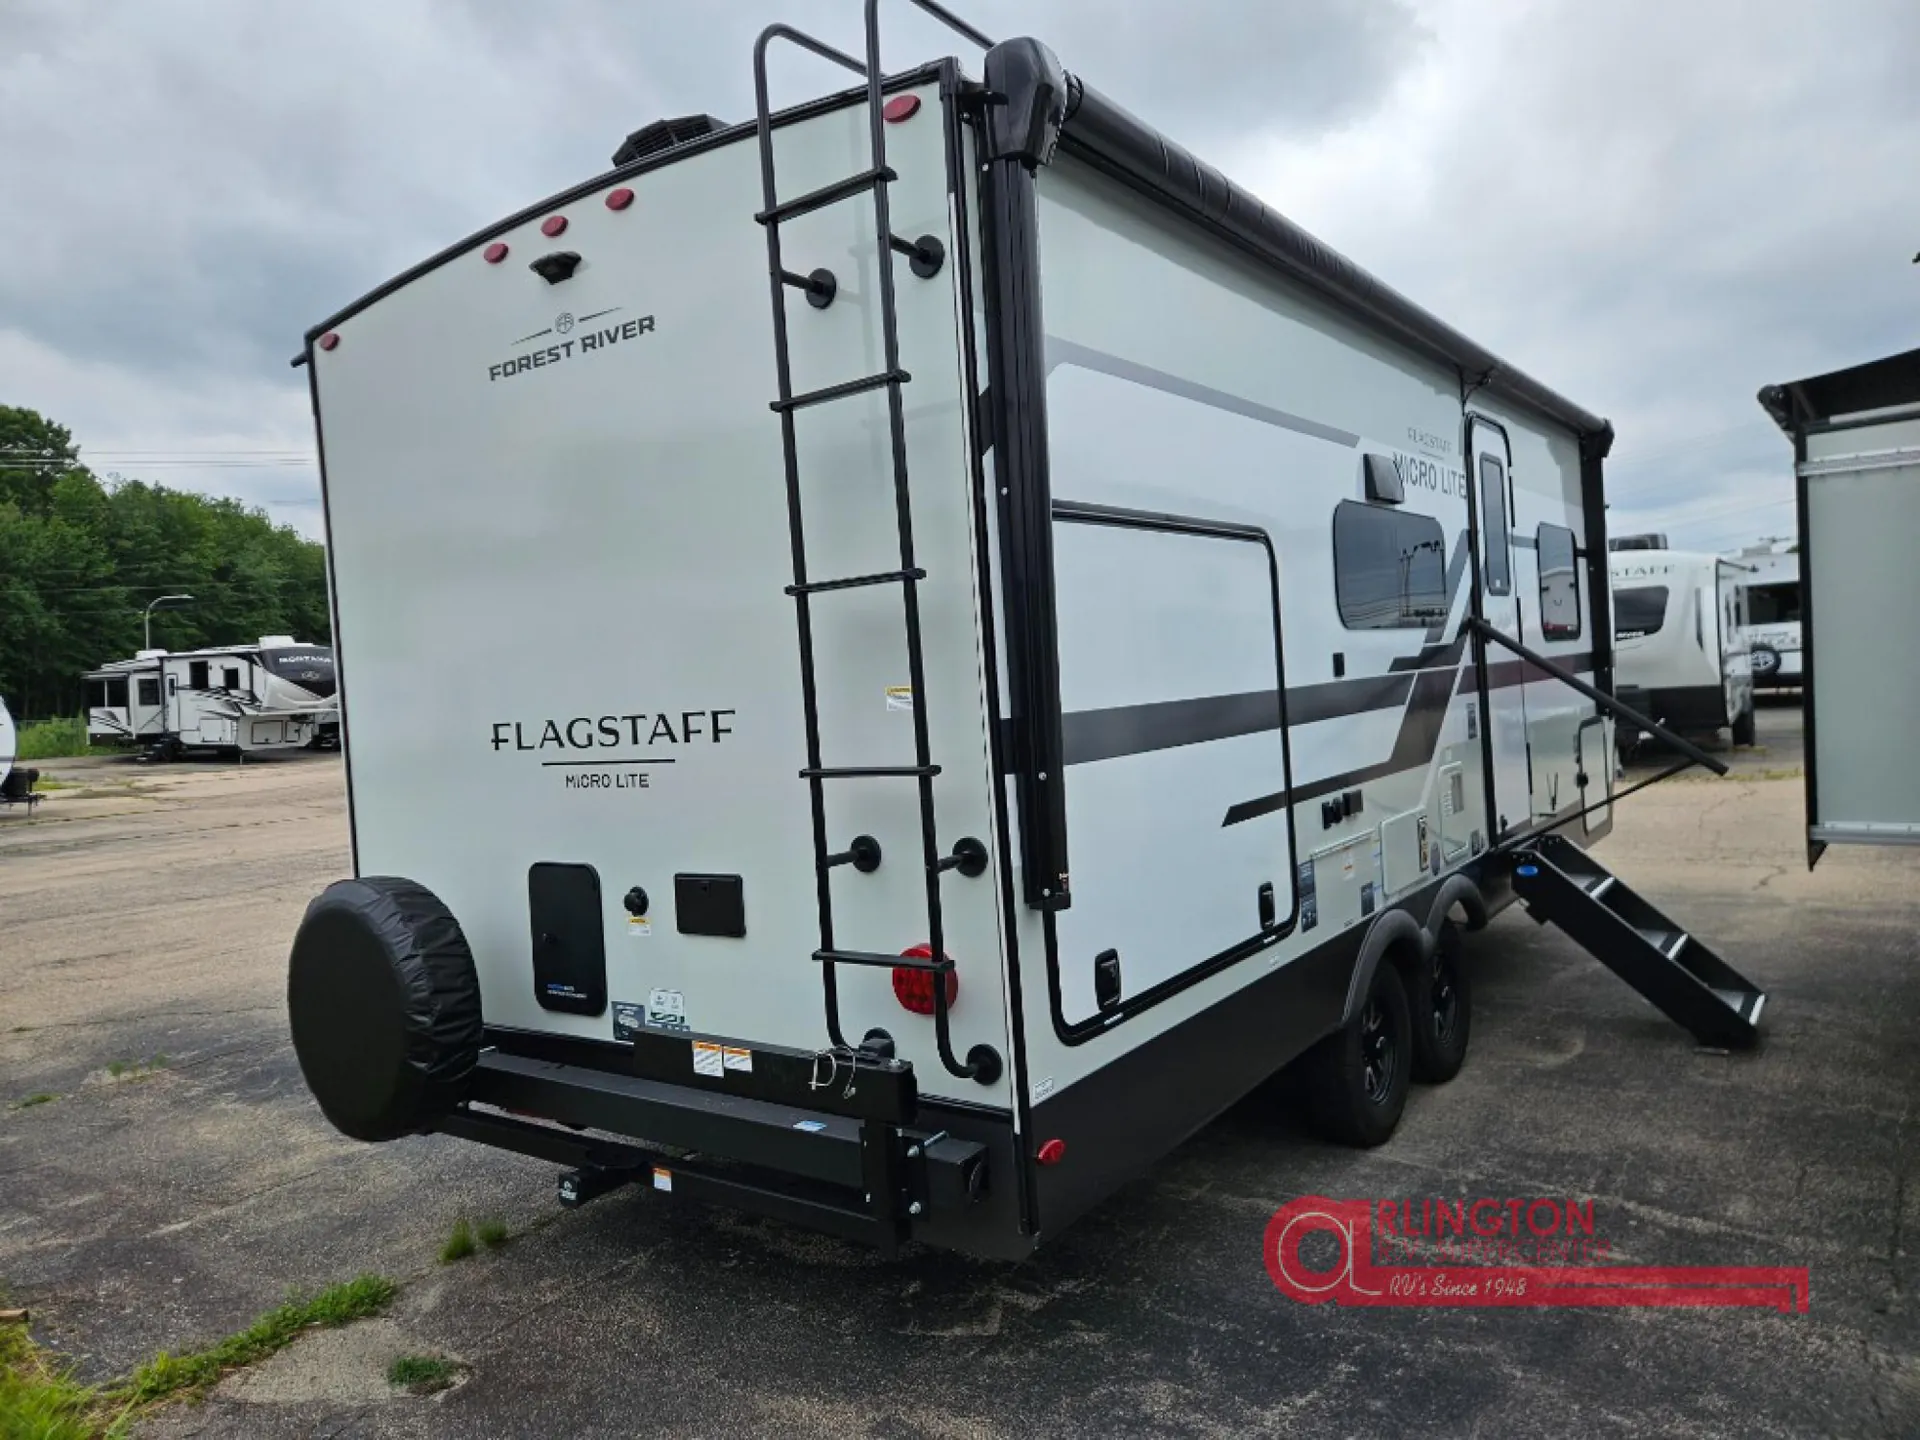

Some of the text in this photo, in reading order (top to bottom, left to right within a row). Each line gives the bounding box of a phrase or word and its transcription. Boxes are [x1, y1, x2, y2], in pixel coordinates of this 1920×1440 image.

[488, 314, 656, 381] FOREST RIVER
[491, 709, 736, 751] FLAGSTAFF
